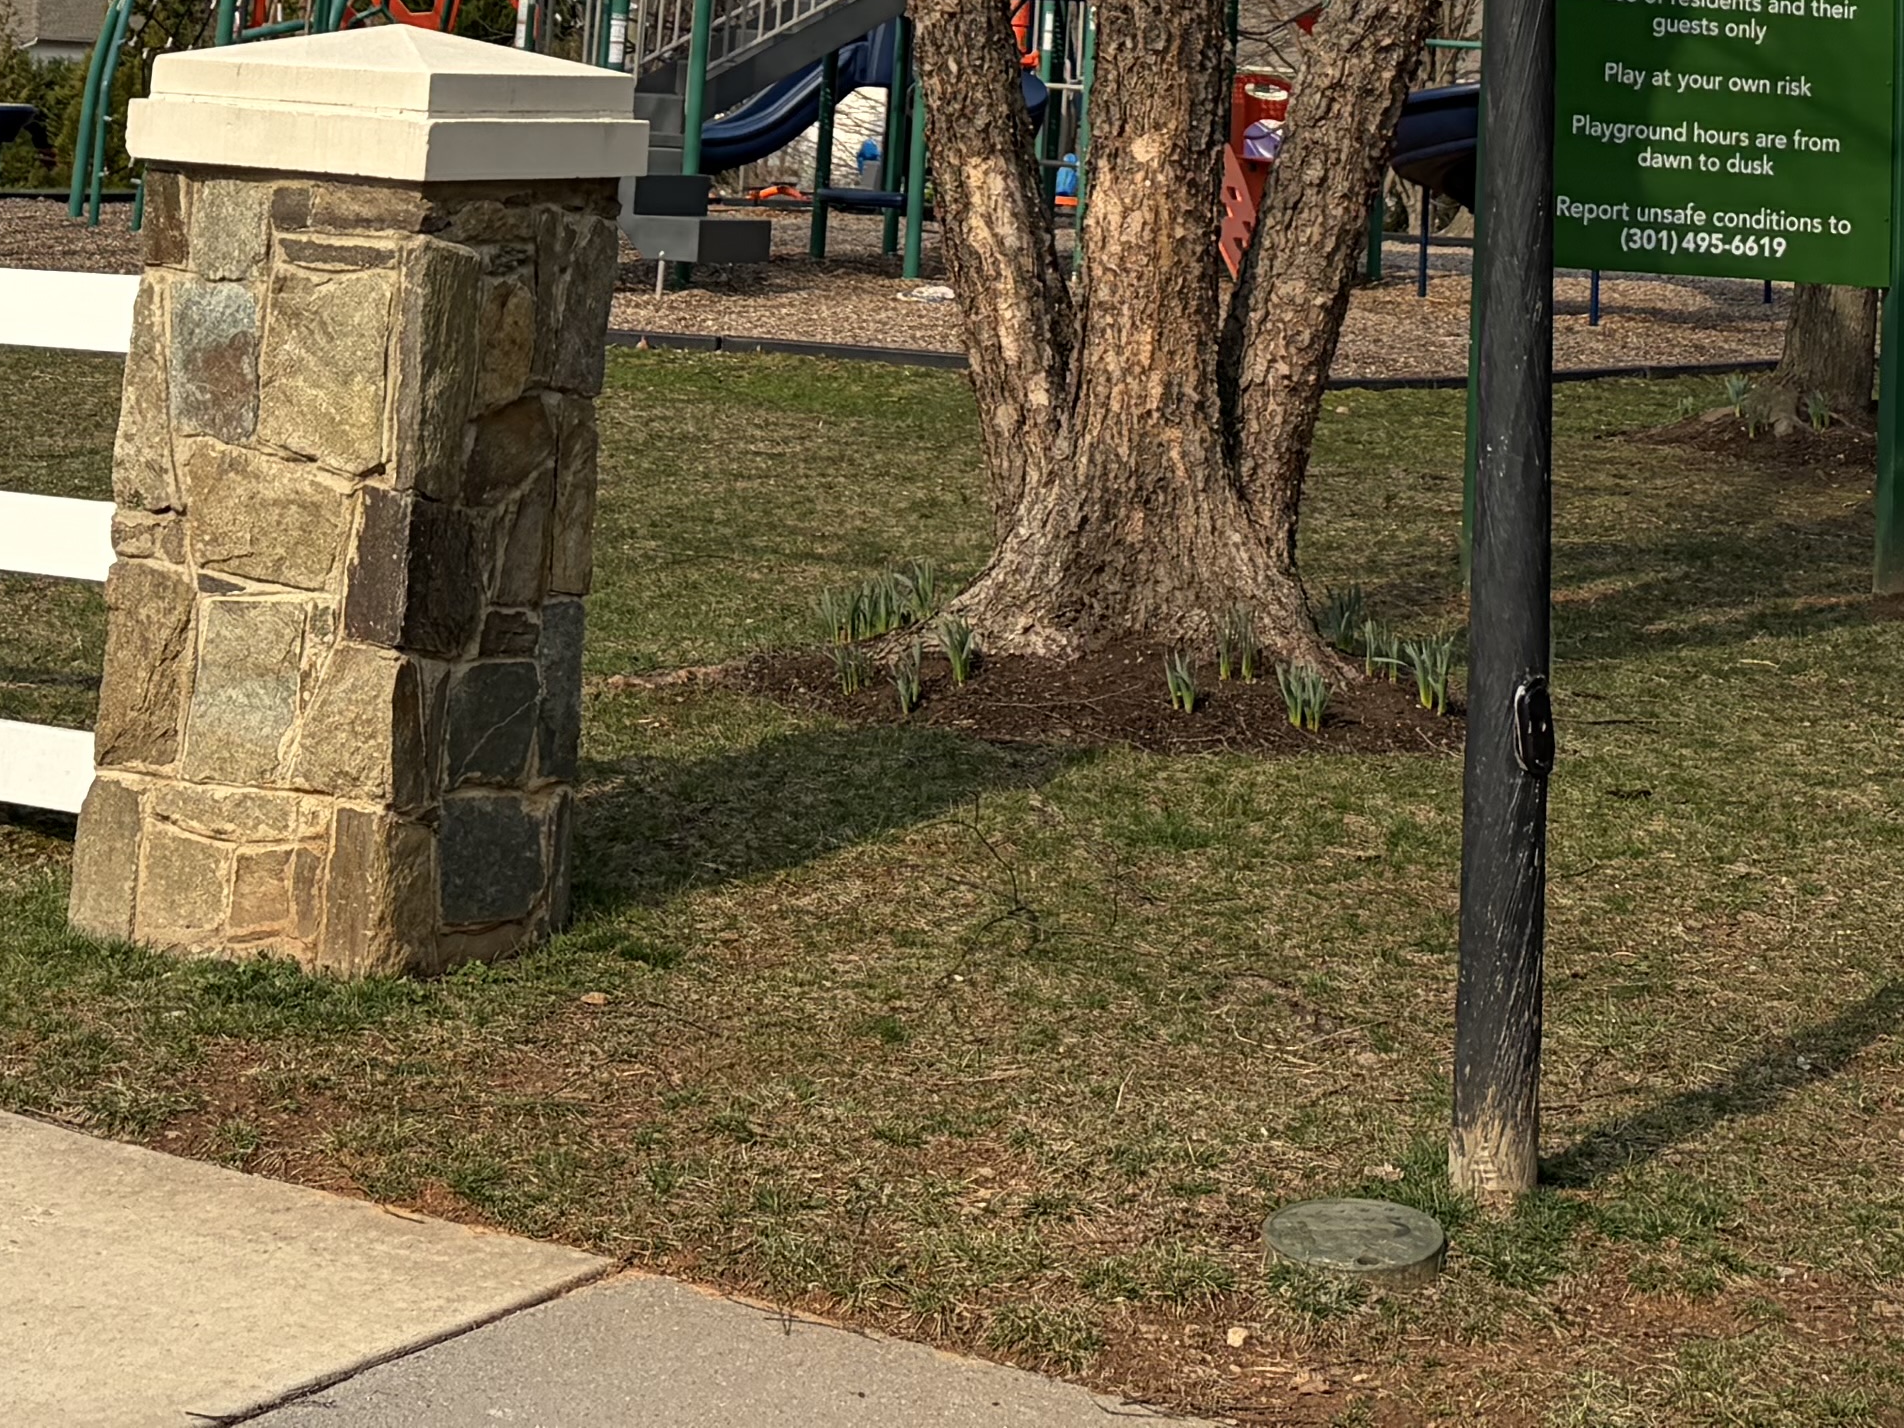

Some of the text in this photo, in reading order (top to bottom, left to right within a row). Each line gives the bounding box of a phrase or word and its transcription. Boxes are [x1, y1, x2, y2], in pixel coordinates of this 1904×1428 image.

[1653, 18, 1766, 44] guests only
[1605, 62, 1811, 96] Play at your own risk
[1573, 114, 1840, 152] Playground hours are from
[1638, 146, 1774, 175] dawn to dusk
[1557, 196, 1851, 234] Report unsafe conditions to
[1621, 228, 1786, 258] (301) 495-6619
